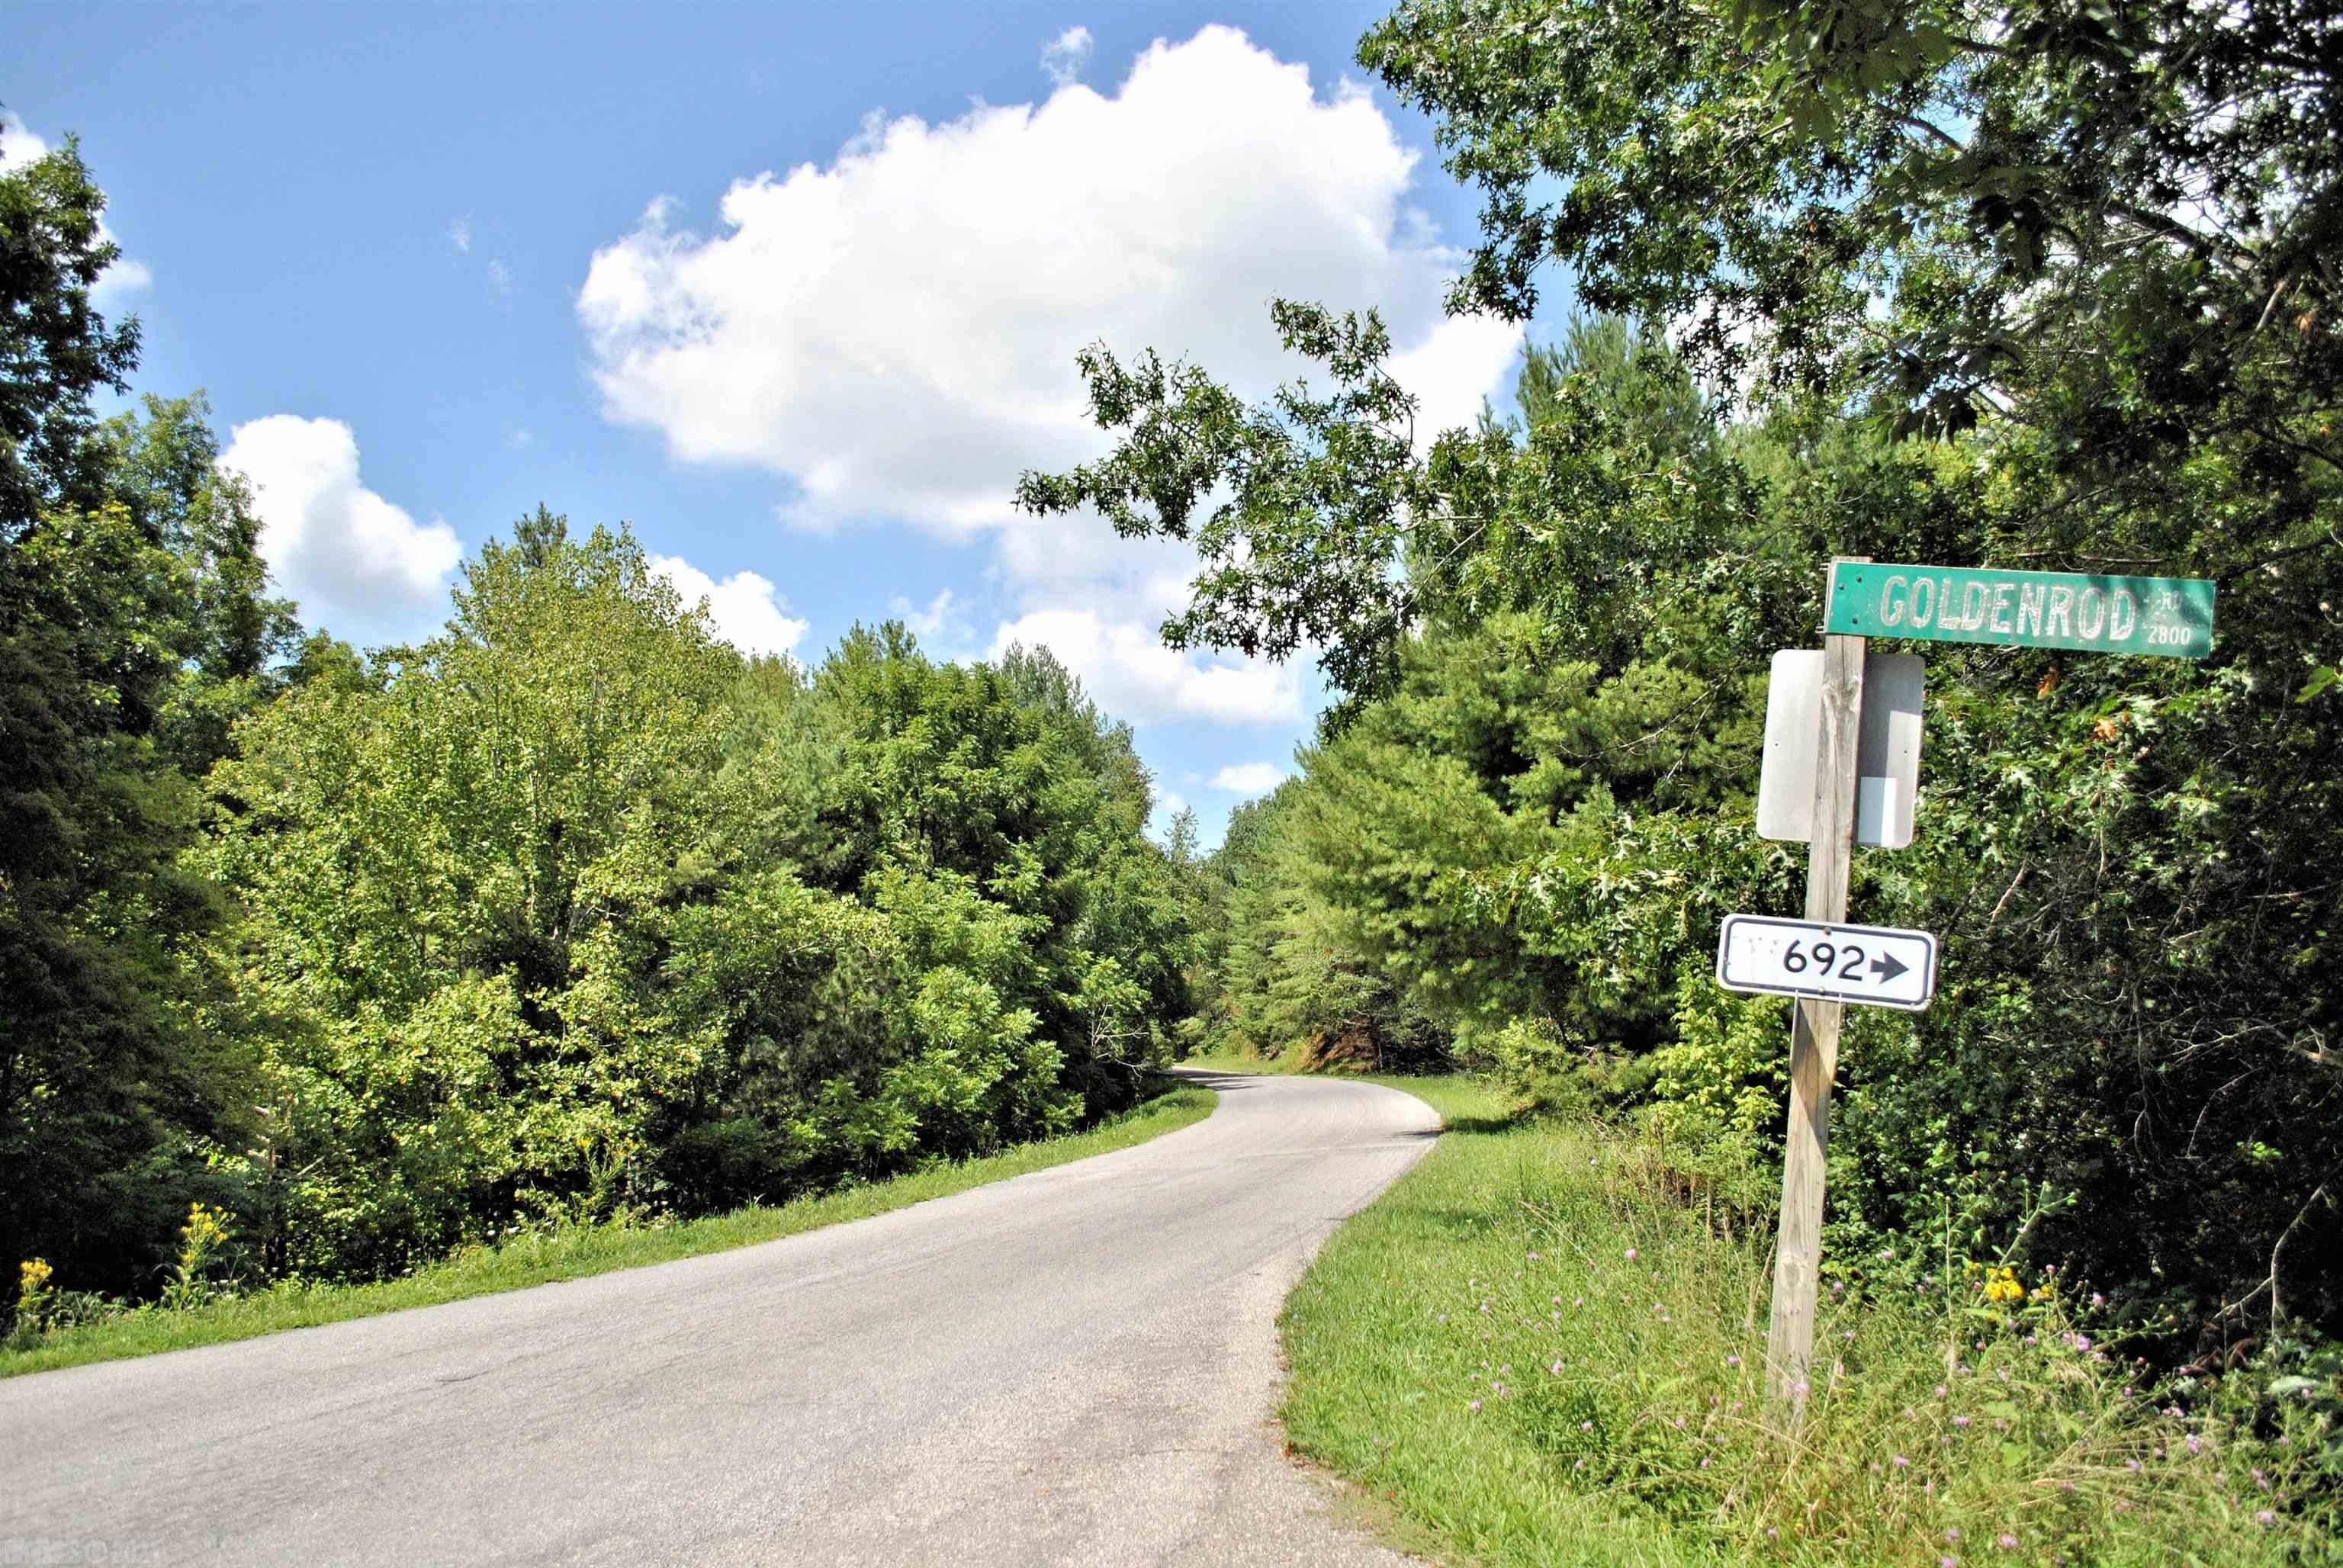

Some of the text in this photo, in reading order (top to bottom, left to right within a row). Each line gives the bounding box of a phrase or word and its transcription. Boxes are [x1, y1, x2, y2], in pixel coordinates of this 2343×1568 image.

[1880, 575, 2137, 641] GOLDENROD
[2148, 625, 2190, 646] 2800
[1783, 939, 1866, 982] 692
